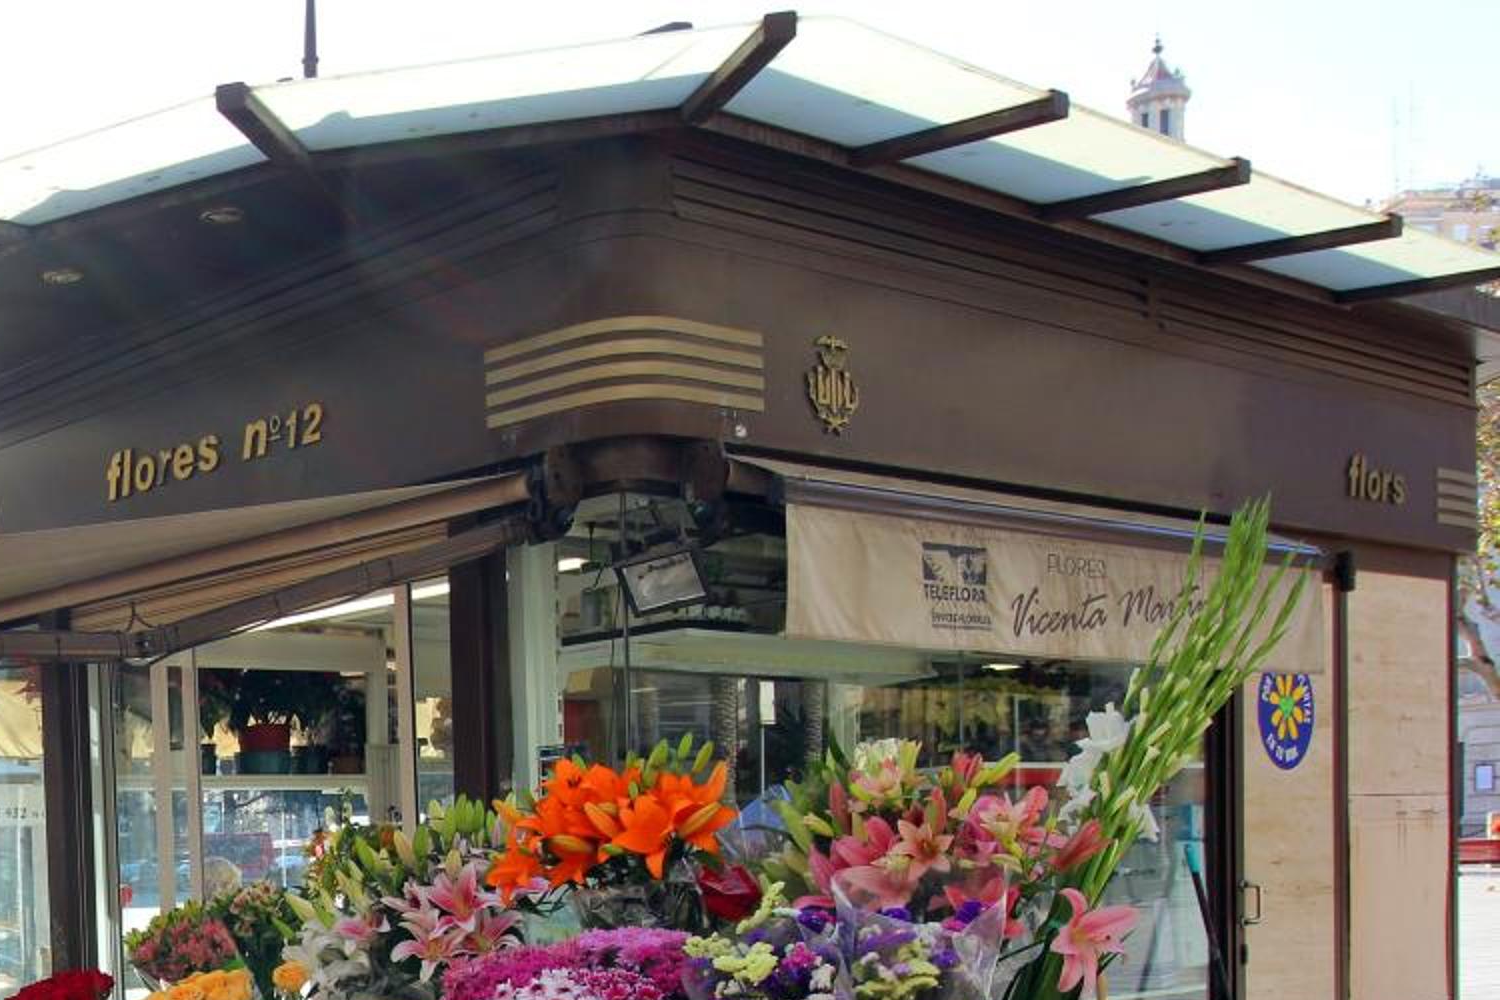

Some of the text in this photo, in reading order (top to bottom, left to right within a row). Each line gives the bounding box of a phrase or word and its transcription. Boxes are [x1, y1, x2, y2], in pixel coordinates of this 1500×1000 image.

[107, 434, 220, 500] flores
[1349, 454, 1406, 504] flors
[1047, 553, 1107, 578] FLORES
[924, 583, 987, 603] TELEFLORA
[1012, 587, 1107, 637] Vicenta
